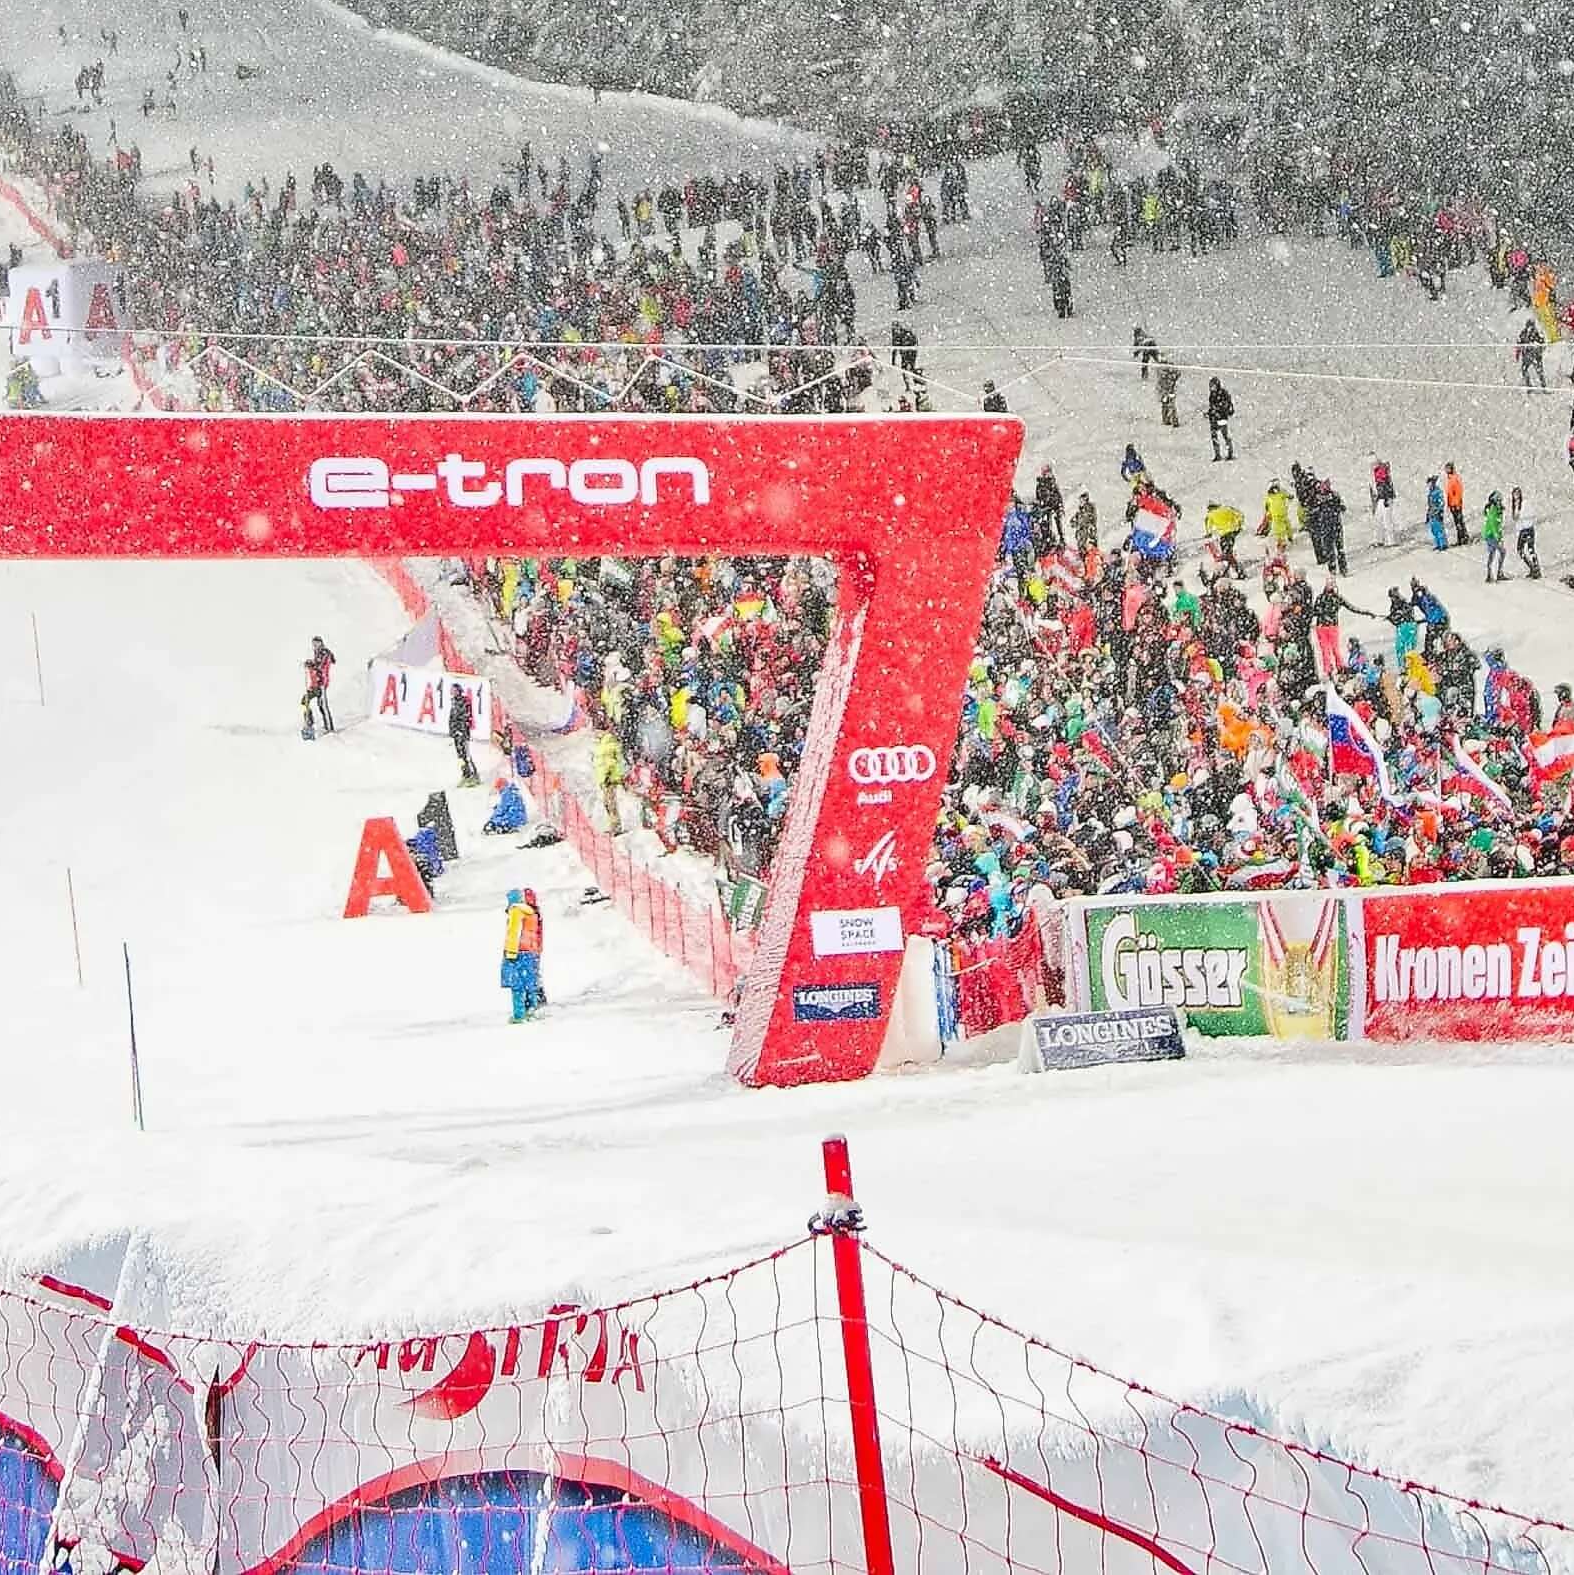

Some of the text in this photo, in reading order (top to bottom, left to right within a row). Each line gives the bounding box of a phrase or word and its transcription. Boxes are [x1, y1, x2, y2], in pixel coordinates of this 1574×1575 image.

[19, 279, 61, 344] A1
[310, 453, 711, 509] e-tron
[379, 672, 408, 716] A1
[418, 677, 444, 724] A1
[857, 790, 893, 805] Audi
[343, 790, 459, 919] A1
[1101, 912, 1249, 1011] Gösser
[1374, 934, 1513, 1002] Kronen
[797, 989, 874, 1005] LONGINES
[1039, 1015, 1174, 1049] LONGINES
